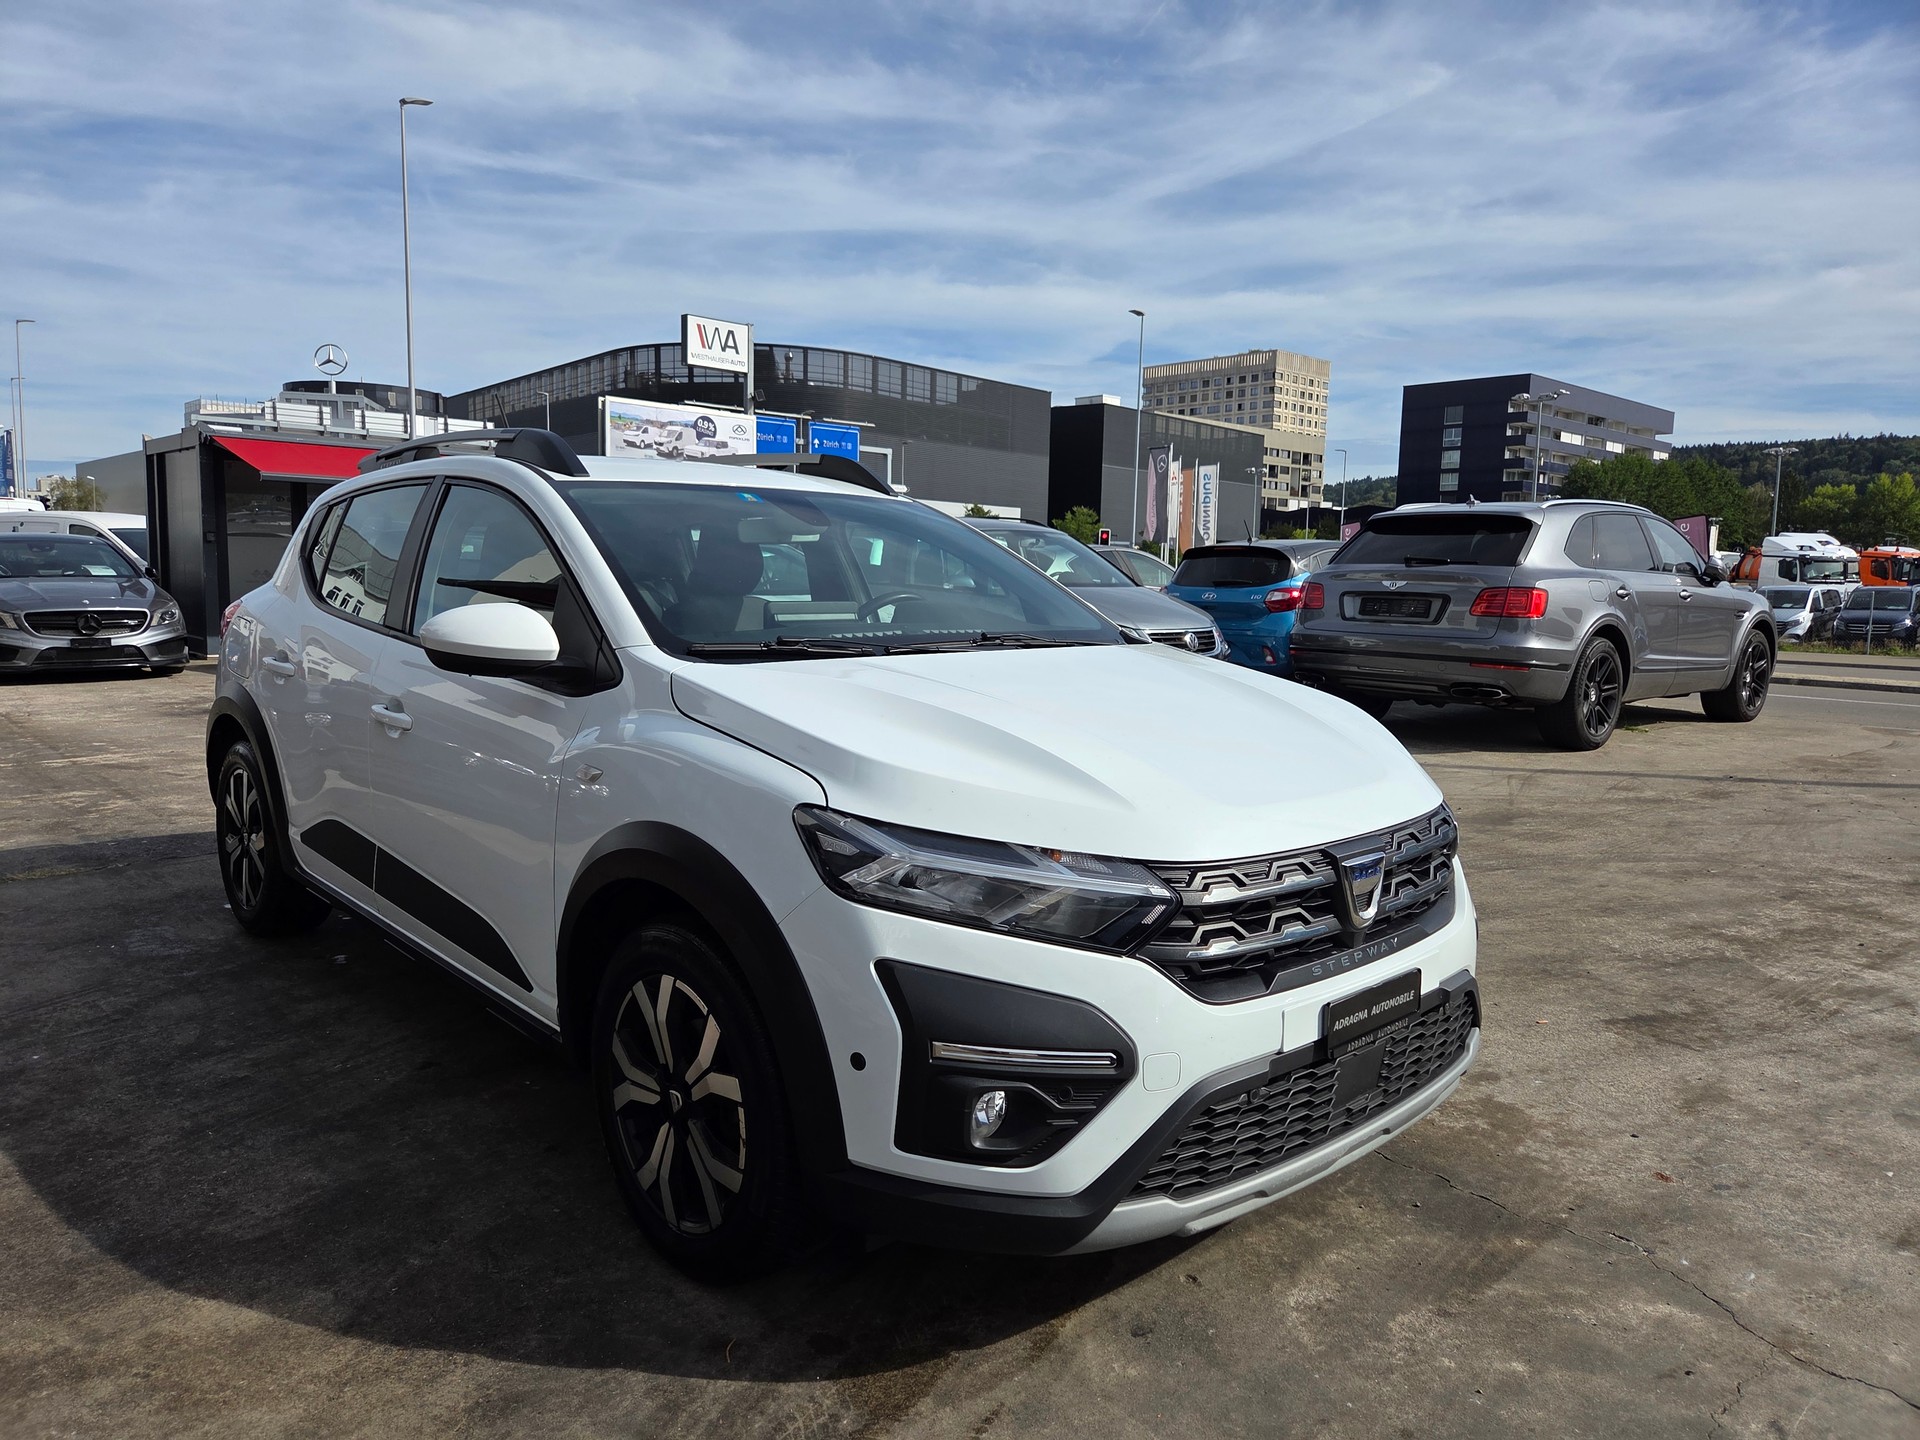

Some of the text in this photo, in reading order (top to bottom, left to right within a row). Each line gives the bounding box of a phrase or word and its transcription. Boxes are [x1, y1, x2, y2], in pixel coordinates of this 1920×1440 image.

[691, 352, 746, 367] WESTHAUSER-AUTO
[757, 432, 775, 442] Zürich
[823, 439, 840, 449] Zürich
[1311, 936, 1399, 976] STEPWAY
[1333, 990, 1416, 1032] ADRAGNA AUTOMOBILE
